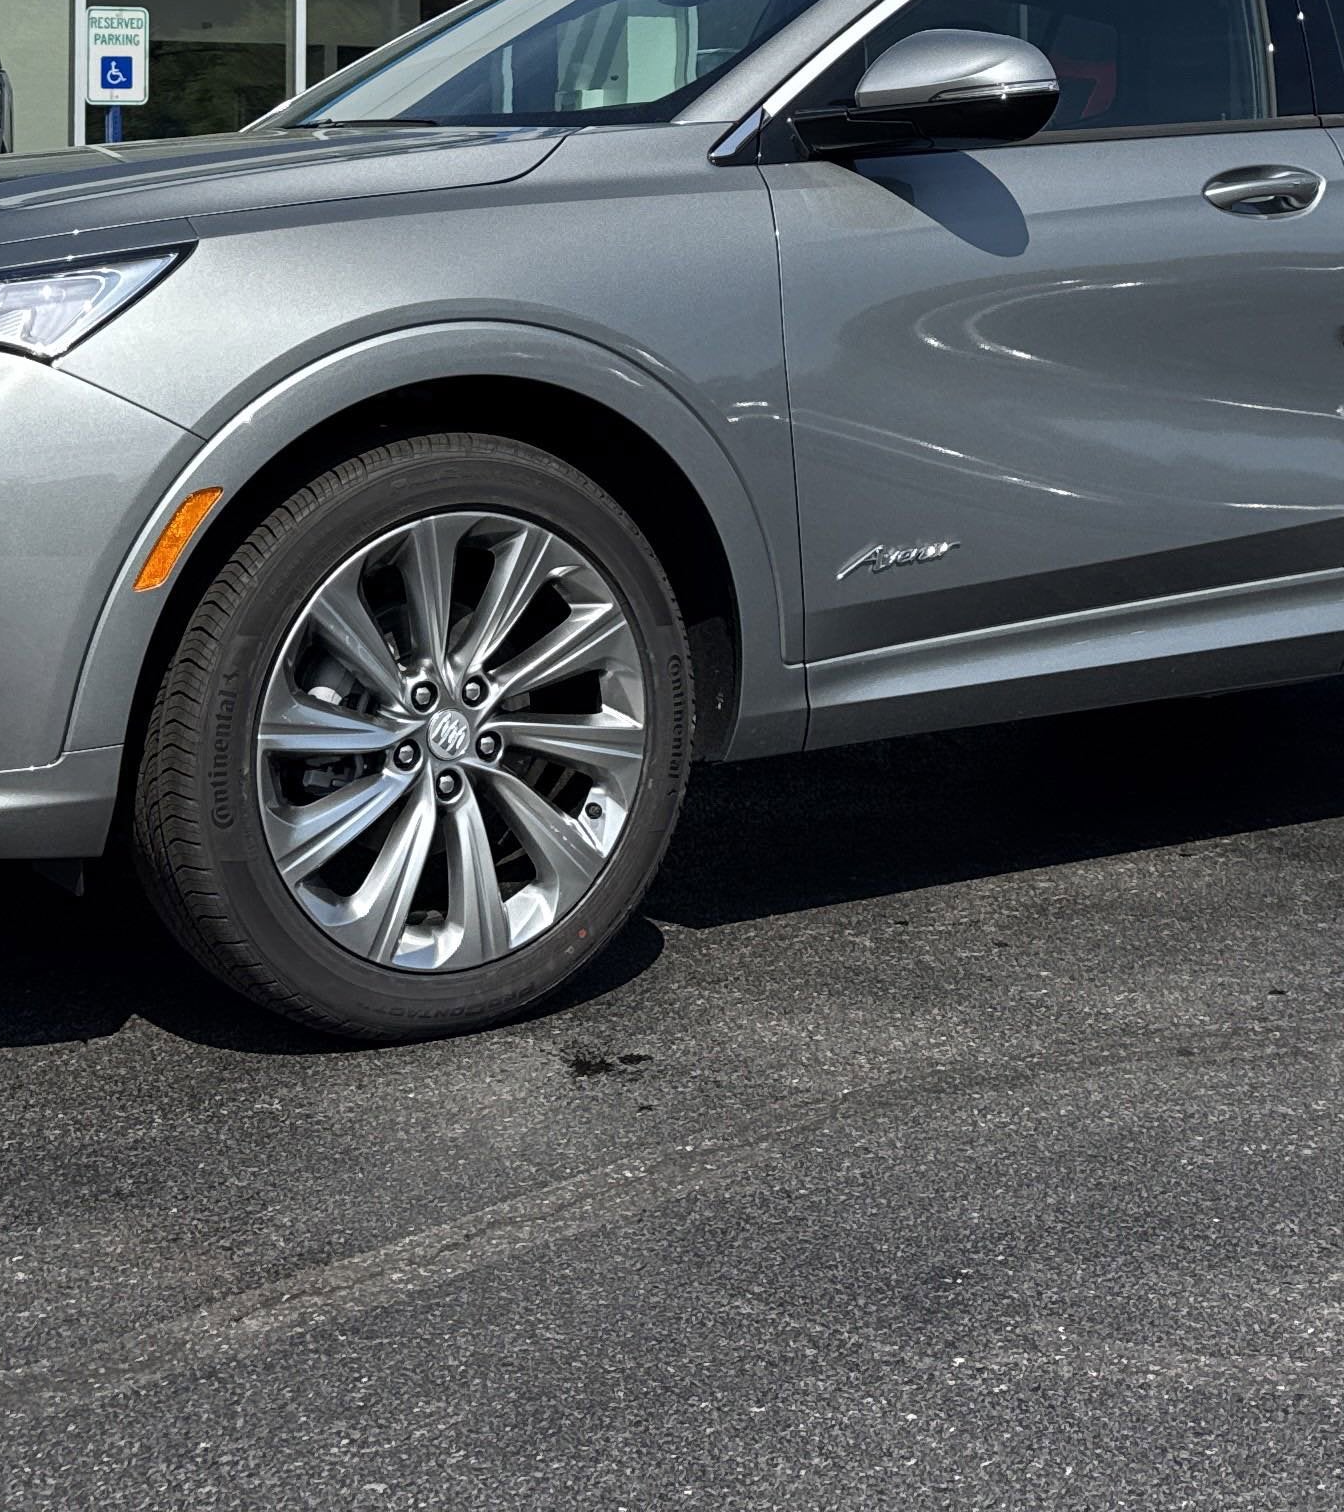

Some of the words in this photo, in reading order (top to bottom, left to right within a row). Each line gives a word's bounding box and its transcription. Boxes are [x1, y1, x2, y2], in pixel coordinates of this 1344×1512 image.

[90, 16, 144, 30] RESERVED
[94, 34, 140, 46] PARKING
[666, 654, 685, 780] Continental
[207, 688, 239, 830] Continental
